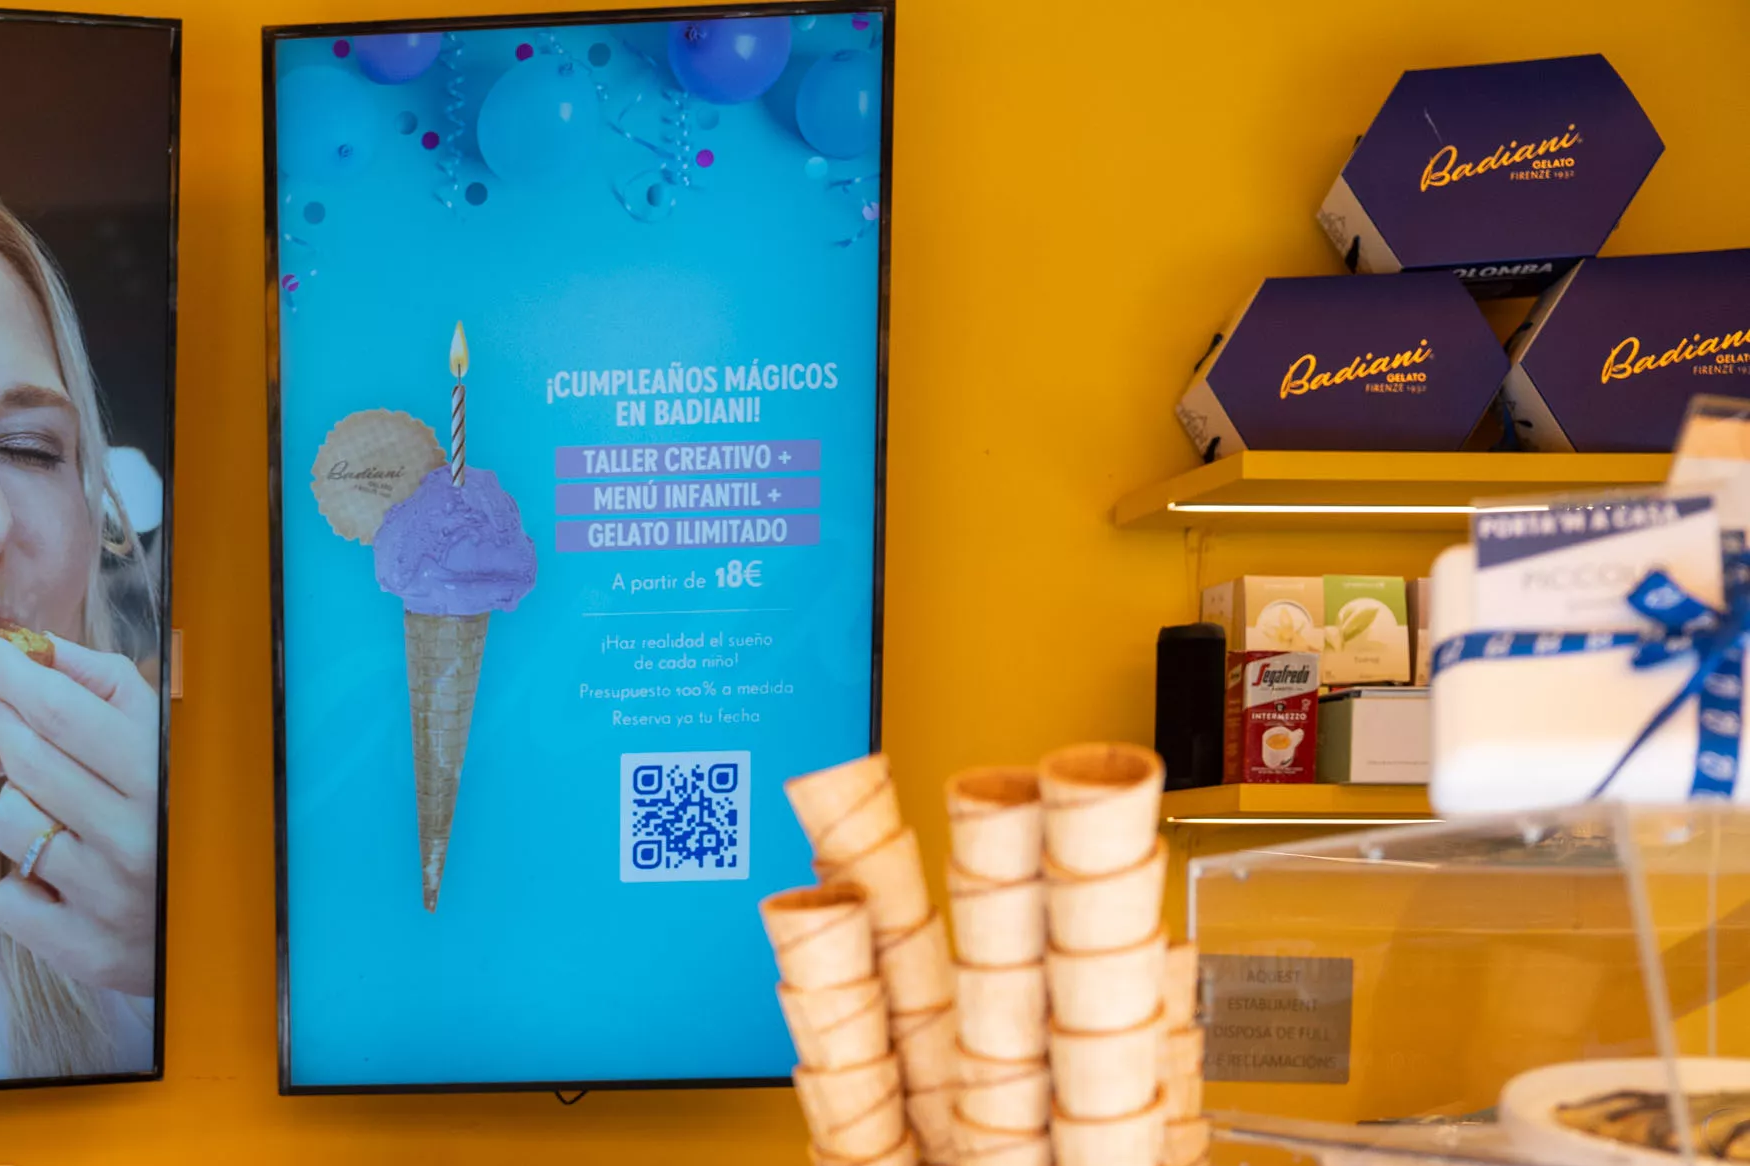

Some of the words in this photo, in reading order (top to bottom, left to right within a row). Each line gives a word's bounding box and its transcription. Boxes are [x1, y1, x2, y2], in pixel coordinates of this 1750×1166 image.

[1420, 123, 1579, 192] Badiani
[1532, 157, 1575, 170] GELATO
[1510, 169, 1551, 181] FIRENZE
[1453, 262, 1554, 278] OLOMBA
[1280, 339, 1432, 399] Badiani
[1715, 354, 1750, 364] GELAT
[1386, 372, 1427, 383] GELATO
[1693, 364, 1733, 375] FIRENZE
[546, 361, 718, 404] ¡CUMPLEAÑOS
[725, 358, 838, 392] MÁGICOS
[1365, 383, 1403, 393] FIRENZE
[616, 400, 646, 427] EN
[654, 397, 760, 425] BADIANI!
[583, 448, 658, 474] TALLER
[664, 444, 771, 472] CREATIVO
[593, 479, 657, 511] MENÚ
[665, 482, 762, 508] INFANTIL
[588, 520, 669, 548] GELATO
[676, 518, 788, 545] ILIMITADO
[612, 572, 625, 590] A
[631, 574, 678, 594] partir
[683, 571, 706, 588] de
[715, 559, 763, 588] 18€
[601, 634, 636, 654] ¡Haz
[641, 632, 704, 649] realidad
[710, 631, 723, 647] el
[728, 633, 773, 647] sueño
[633, 655, 653, 670] de
[658, 653, 697, 670] cada
[1251, 663, 1311, 686] Segafredo
[579, 683, 672, 701] Presupuesto
[676, 681, 717, 697] 100%
[721, 685, 732, 696] a
[737, 680, 794, 695] medida
[612, 710, 671, 726] Reserva
[676, 713, 693, 727] ya
[699, 711, 713, 724] tu
[718, 707, 761, 723] fecha
[1251, 711, 1308, 721] INTERMEZZO
[1213, 1025, 1272, 1040] DISPOSA
[1276, 1027, 1296, 1040] DE
